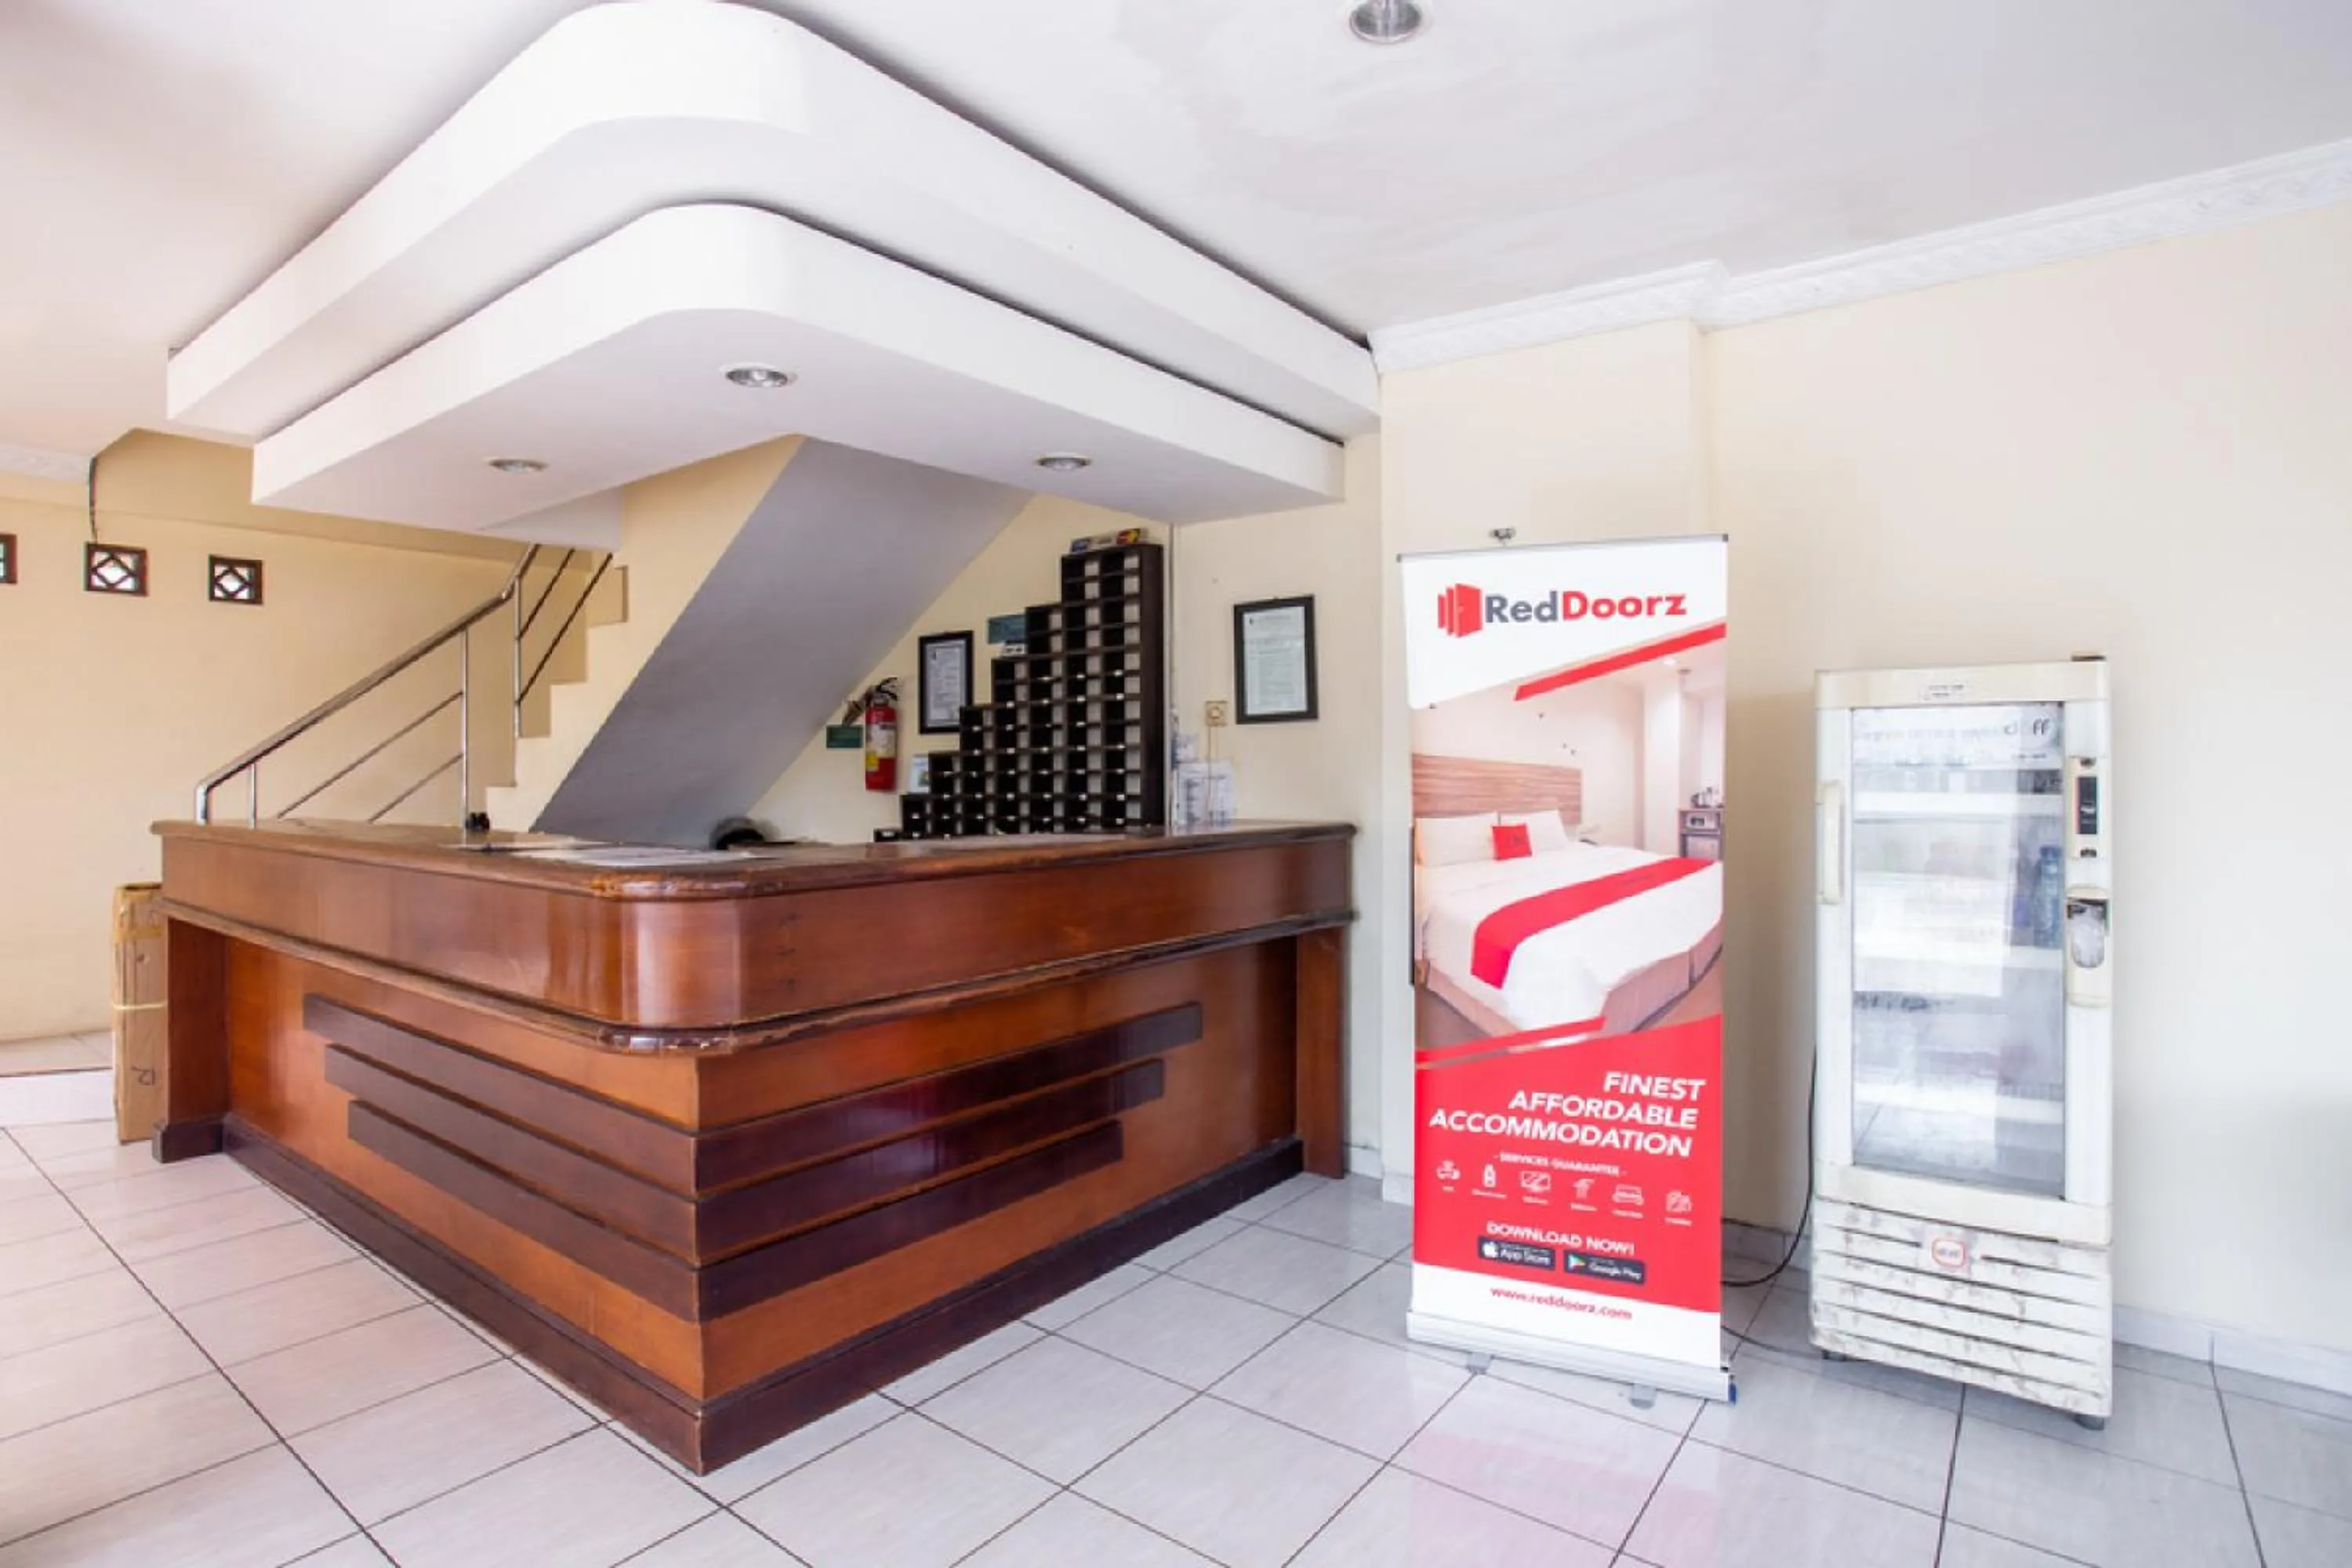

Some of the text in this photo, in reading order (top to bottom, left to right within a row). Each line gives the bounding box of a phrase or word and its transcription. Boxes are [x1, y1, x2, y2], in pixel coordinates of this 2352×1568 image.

[1485, 590, 1688, 623] RedDoorz
[1603, 1072, 1707, 1101] FINEST
[1508, 1090, 1699, 1129] AFFORDABLE
[1428, 1109, 1693, 1157] ACCOMMODATION
[1486, 1221, 1635, 1255] DOWNLOAD NOW!
[1500, 1248, 1523, 1261] App
[1490, 1287, 1633, 1319] www.reddoorz.com
